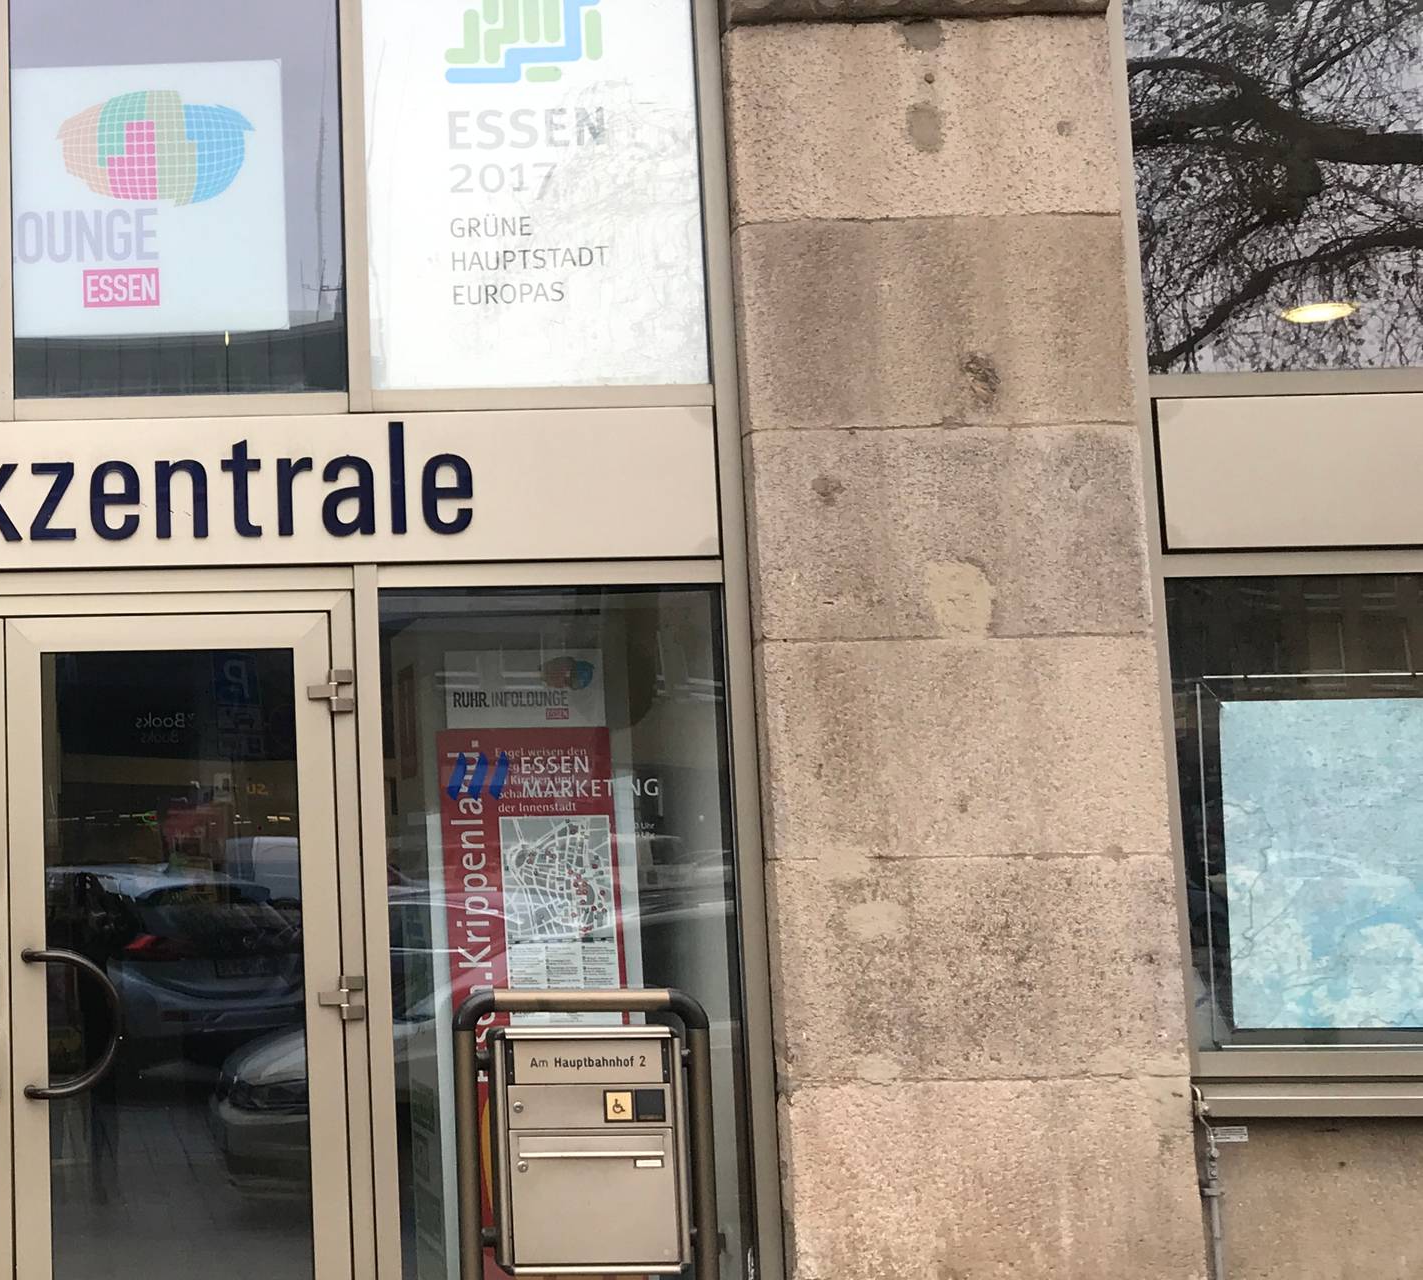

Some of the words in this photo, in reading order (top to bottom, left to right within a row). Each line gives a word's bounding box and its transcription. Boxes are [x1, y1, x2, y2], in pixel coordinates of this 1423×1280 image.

[446, 106, 607, 150] ESSEN
[449, 161, 558, 201] 2017
[450, 213, 534, 239] GRÜNE
[451, 245, 610, 272] HAUPTSTADT
[85, 273, 158, 304] ESSEN
[452, 281, 565, 306] EUROPAS
[520, 755, 590, 774] ESSEN
[521, 778, 660, 799] MARKETNG
[497, 802, 516, 813] der
[518, 801, 577, 812] Innenstadt
[529, 1057, 549, 1069] Am
[553, 1055, 635, 1070] Hauptbahnhof
[638, 1055, 647, 1068] 2
